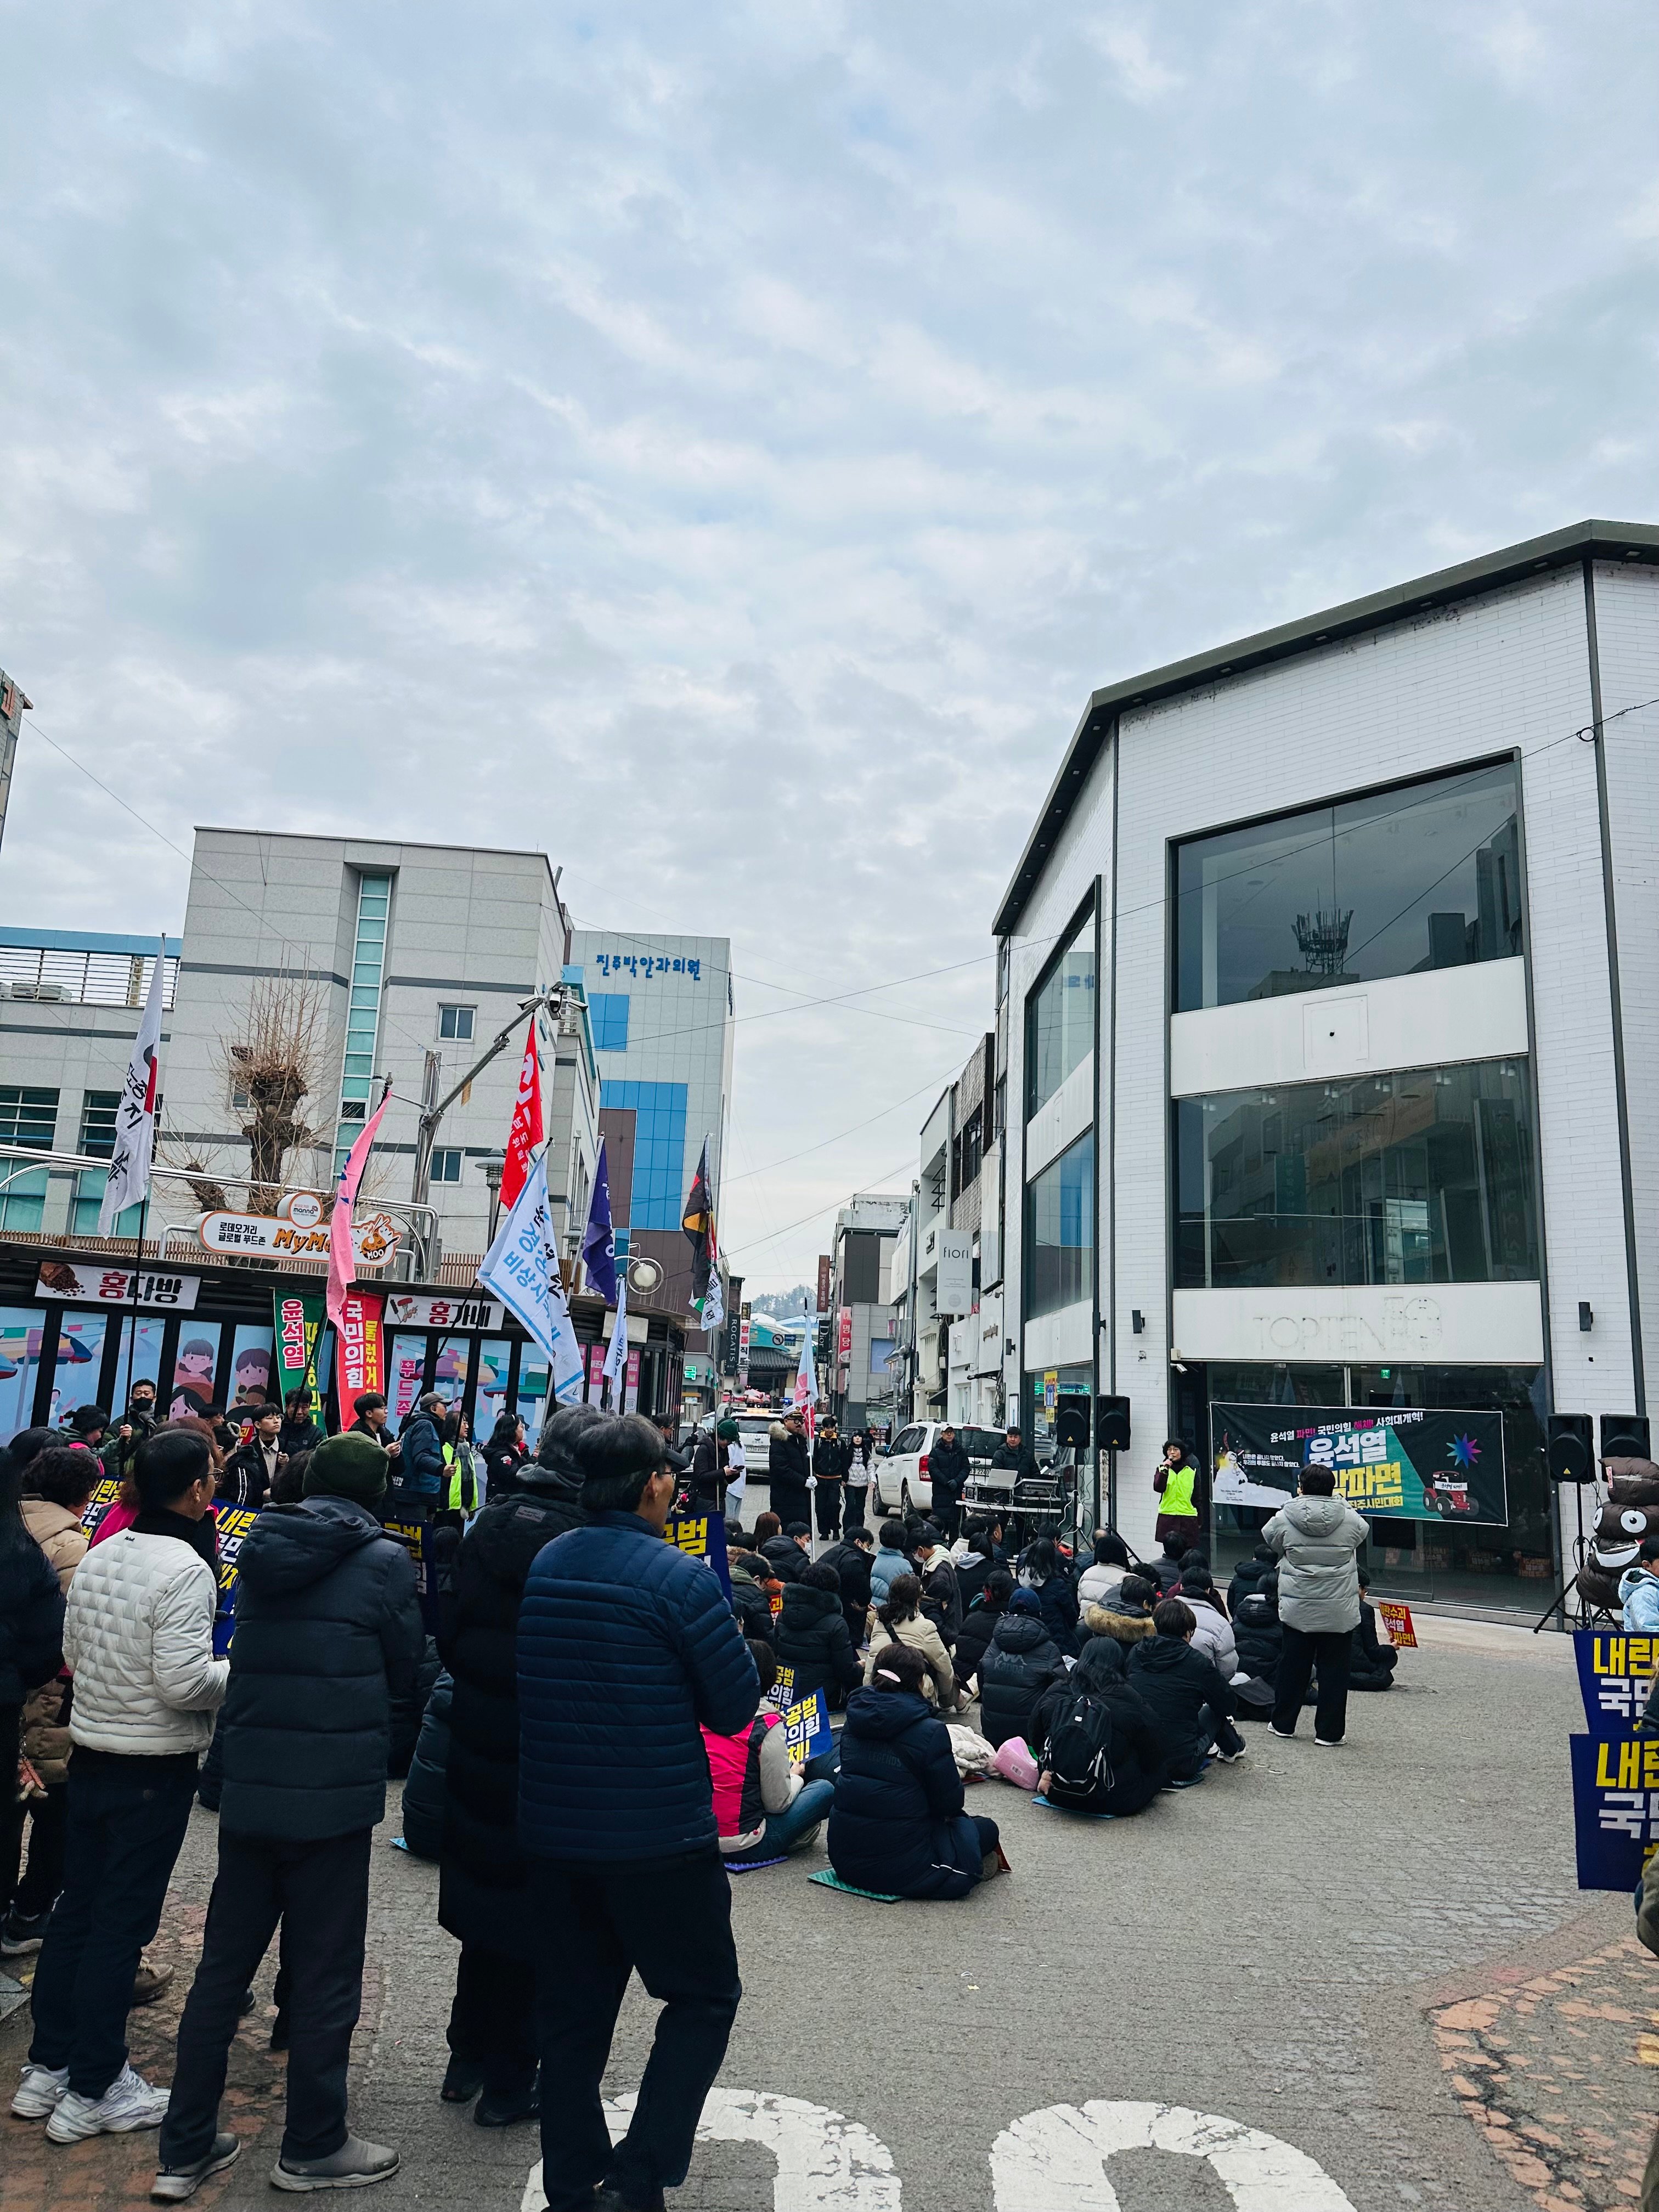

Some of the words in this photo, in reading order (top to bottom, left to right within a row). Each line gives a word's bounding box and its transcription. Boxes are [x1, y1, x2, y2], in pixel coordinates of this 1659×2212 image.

[596, 955, 701, 981] 진주박안과의원
[218, 1232, 241, 1244] 글로벌
[242, 1234, 266, 1246] 푸드존
[219, 1222, 257, 1235] 로데오거리
[366, 1249, 384, 1260] MOO
[943, 1246, 969, 1259] fiori
[99, 1271, 183, 1304] 홍다방
[281, 1298, 306, 1369] 윤석열
[345, 1300, 364, 1389] 국민의힘
[729, 1318, 738, 1362] ROGATIS
[819, 1324, 829, 1348] Dior
[364, 1319, 378, 1393] 물렀거
[395, 1358, 416, 1418] 푸드존
[1270, 1430, 1295, 1443] 윤석열
[1296, 1428, 1316, 1438] 파면!
[1317, 1422, 1352, 1436] 국민의힘
[1353, 1419, 1374, 1431] 해체!
[1376, 1412, 1424, 1427] 사회대개혁!
[1309, 1430, 1387, 1468] 윤석열
[1347, 1496, 1404, 1510] 진주시민대회
[768, 1684, 794, 1706] 의힘
[782, 1694, 817, 1727] 공범
[785, 1713, 820, 1746] 의힘
